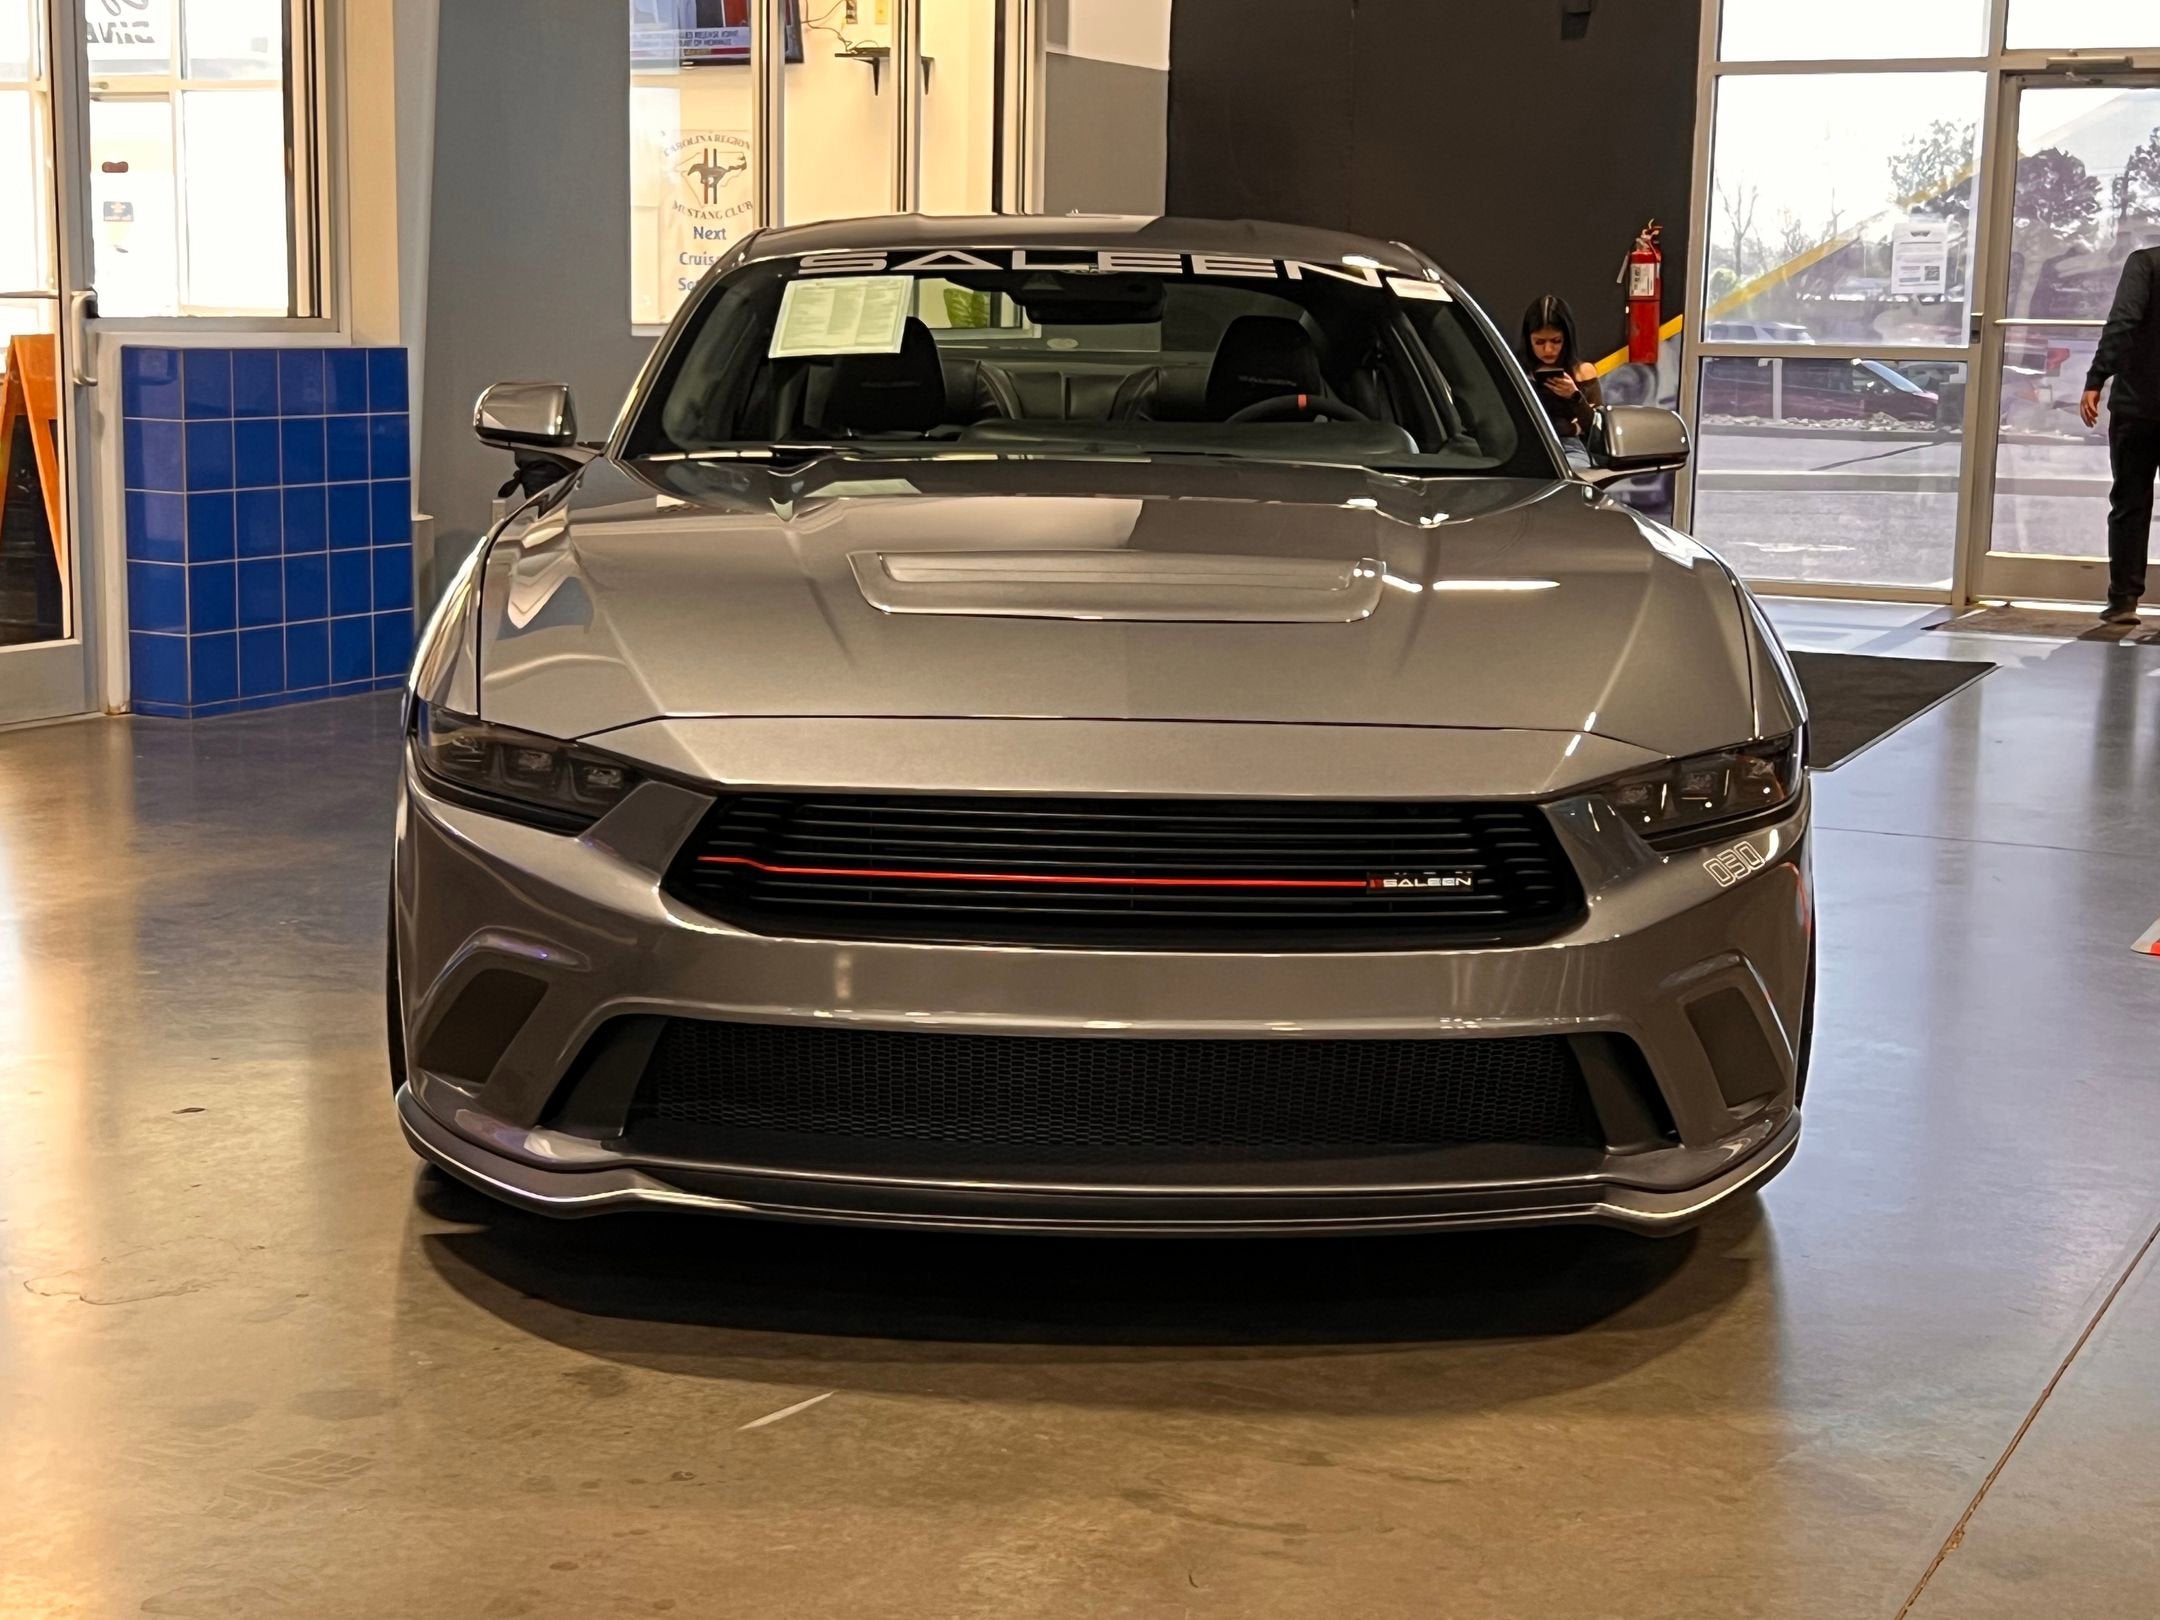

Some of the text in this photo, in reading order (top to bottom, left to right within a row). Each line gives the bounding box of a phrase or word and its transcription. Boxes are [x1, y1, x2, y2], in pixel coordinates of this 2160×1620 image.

[663, 134, 751, 157] CAROLINA REGION
[672, 200, 753, 219] MUSTANG CLUB
[693, 225, 727, 240] Next
[679, 250, 720, 266] Cruis
[798, 249, 1383, 288] SALEEN
[1703, 841, 1765, 887] 030
[1383, 877, 1472, 888] SALEEN
